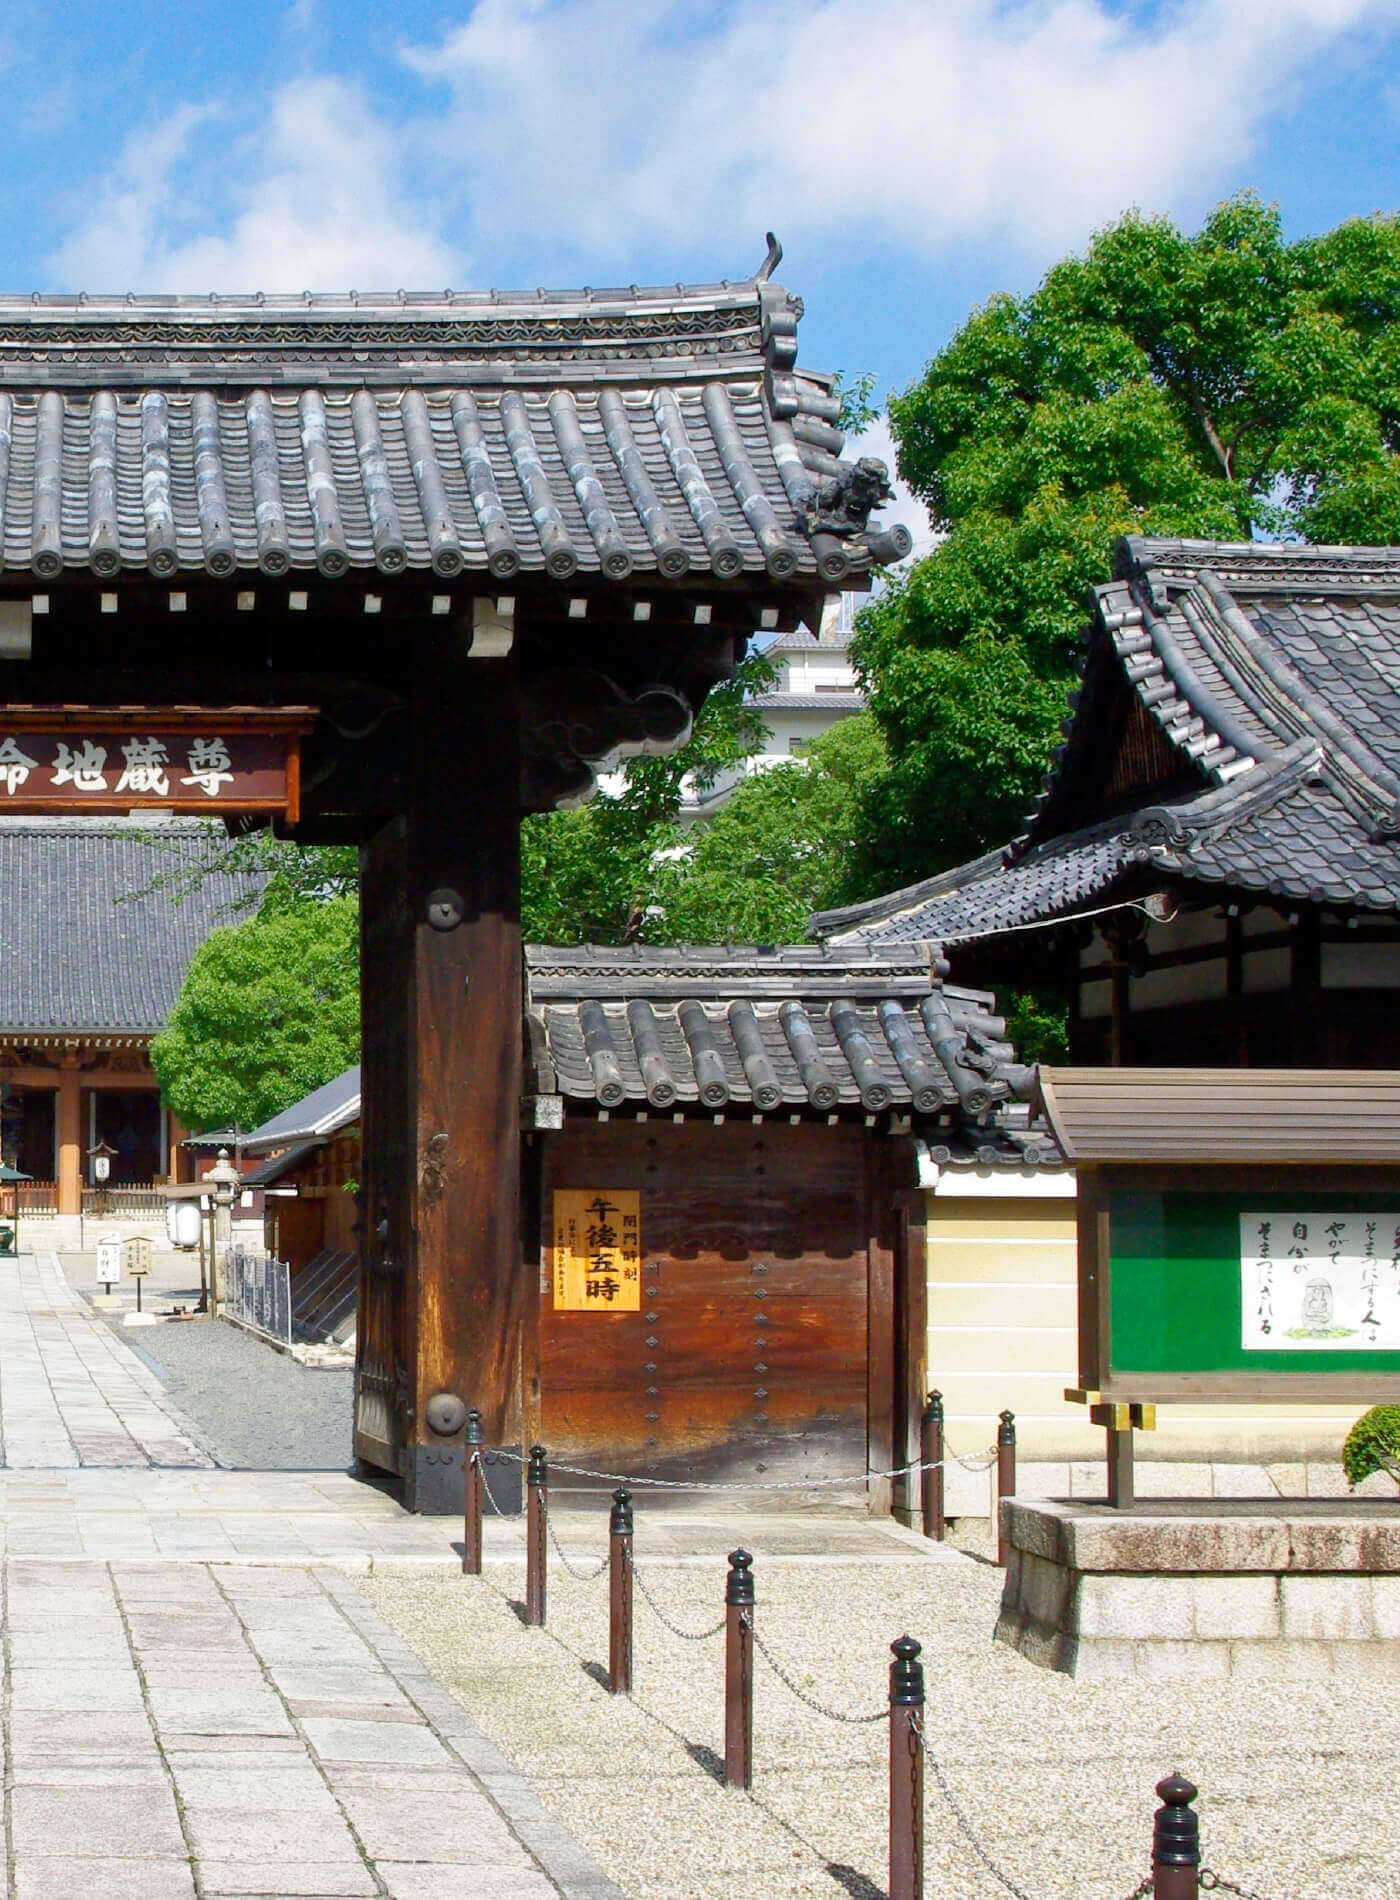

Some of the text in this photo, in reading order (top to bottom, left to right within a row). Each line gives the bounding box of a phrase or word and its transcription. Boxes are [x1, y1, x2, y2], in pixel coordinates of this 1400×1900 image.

[585, 1197, 620, 1302] 午後五時
[1287, 1221, 1310, 1274] 自分が
[1324, 1221, 1350, 1265] やがて
